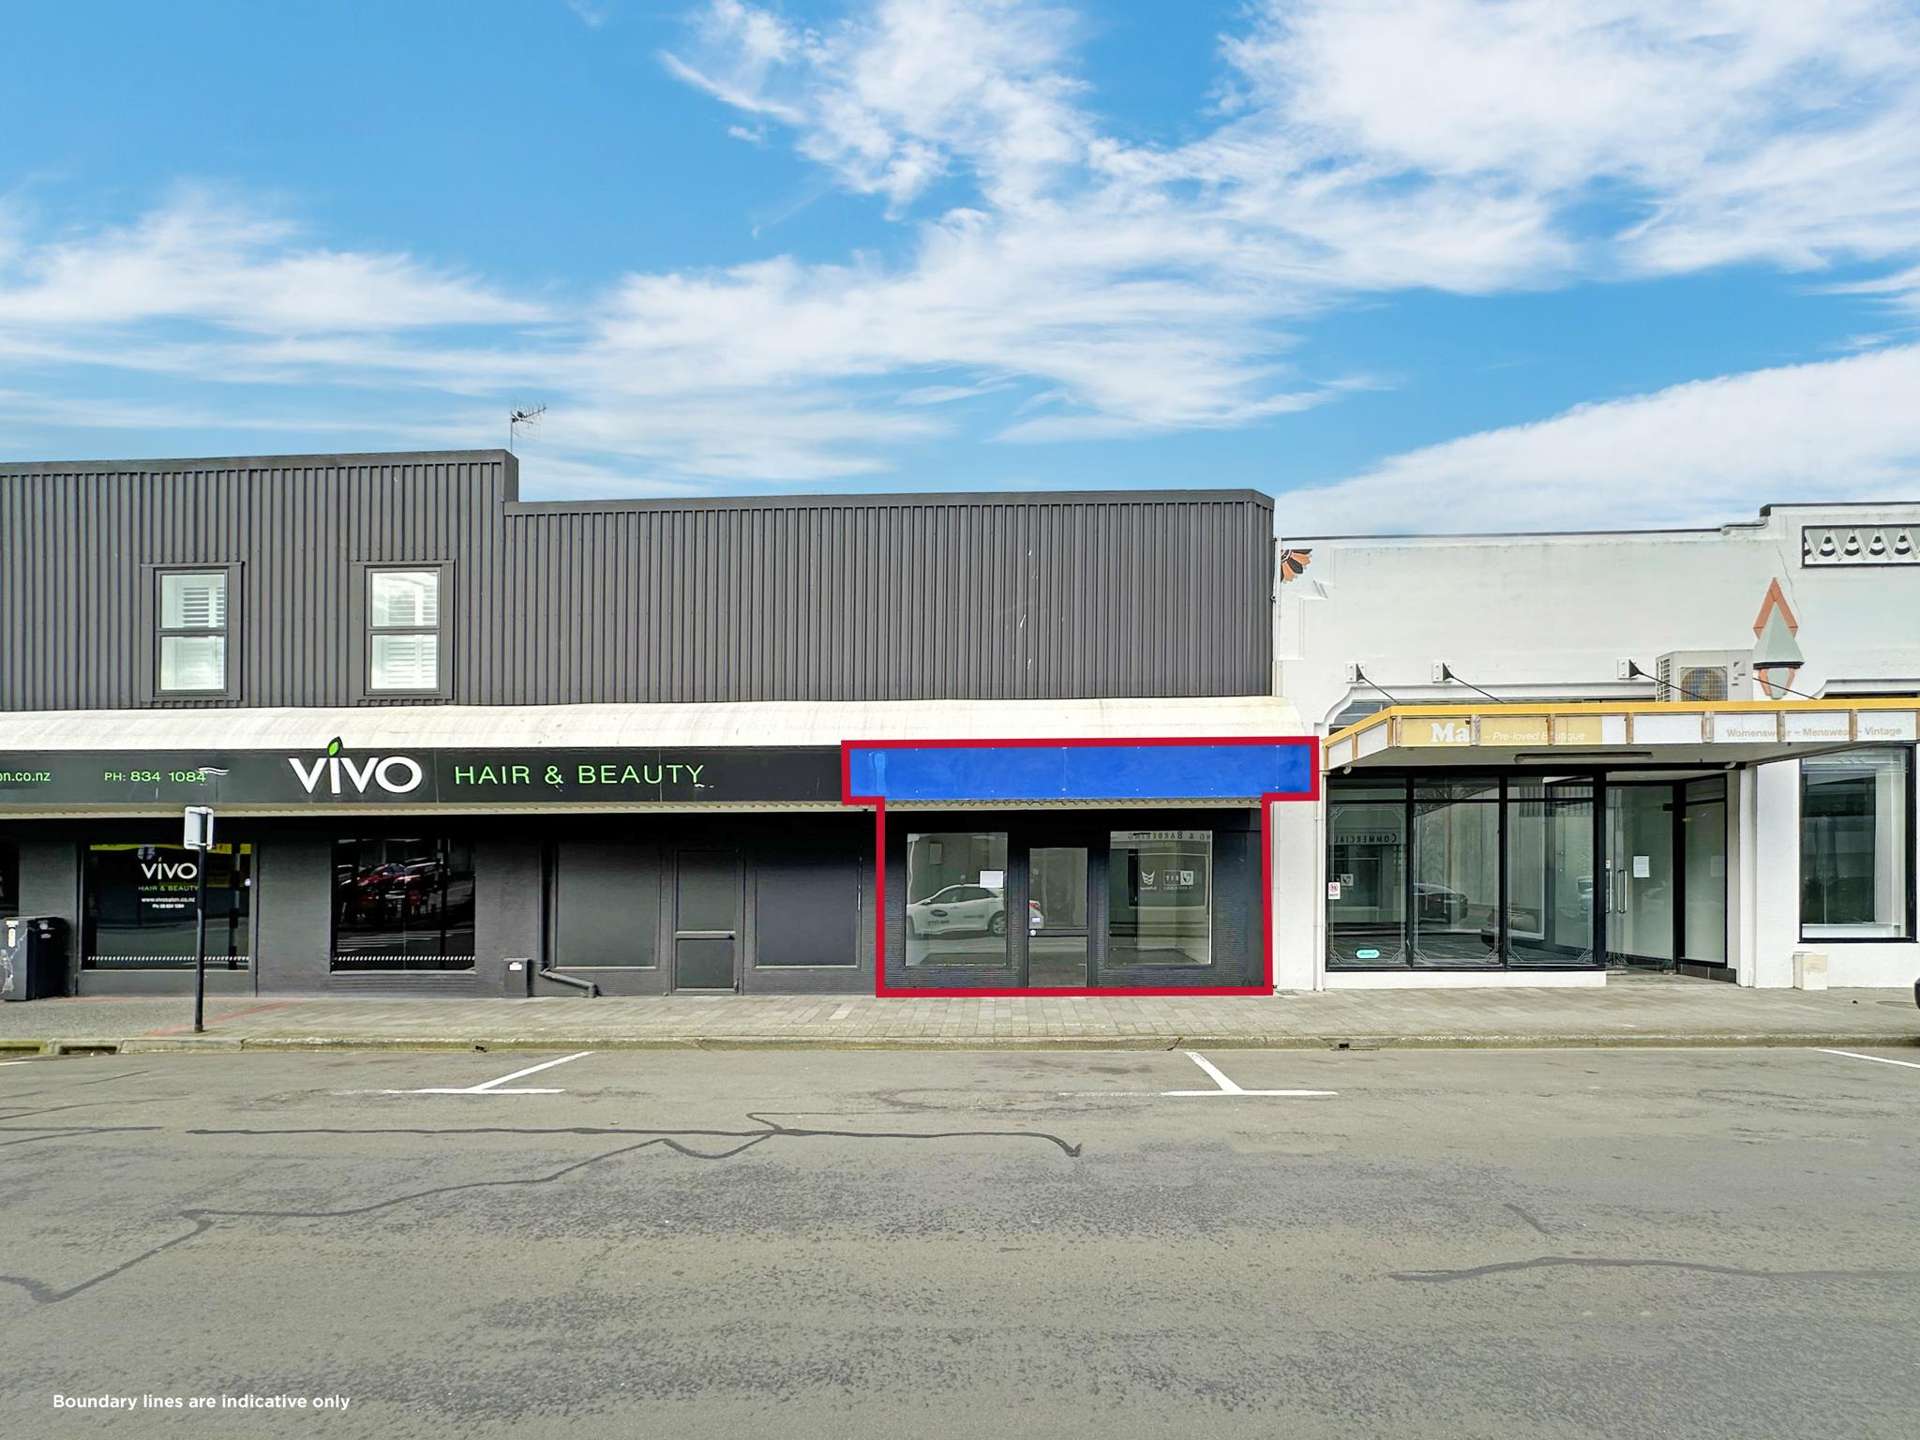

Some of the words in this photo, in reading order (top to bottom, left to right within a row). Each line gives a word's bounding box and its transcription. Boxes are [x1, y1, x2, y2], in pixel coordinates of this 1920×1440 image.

[1431, 723, 1471, 743] Ma
[1542, 731, 1585, 742] Butique
[1727, 728, 1791, 737] Womenswr
[1803, 727, 1850, 737] Menswea
[1865, 726, 1903, 737] Vintage
[104, 773, 127, 782] PH:
[130, 772, 161, 782] 834
[168, 772, 206, 782] 1084
[455, 765, 531, 785] HAIR
[544, 765, 564, 784] &
[578, 764, 704, 784] BEAUTY
